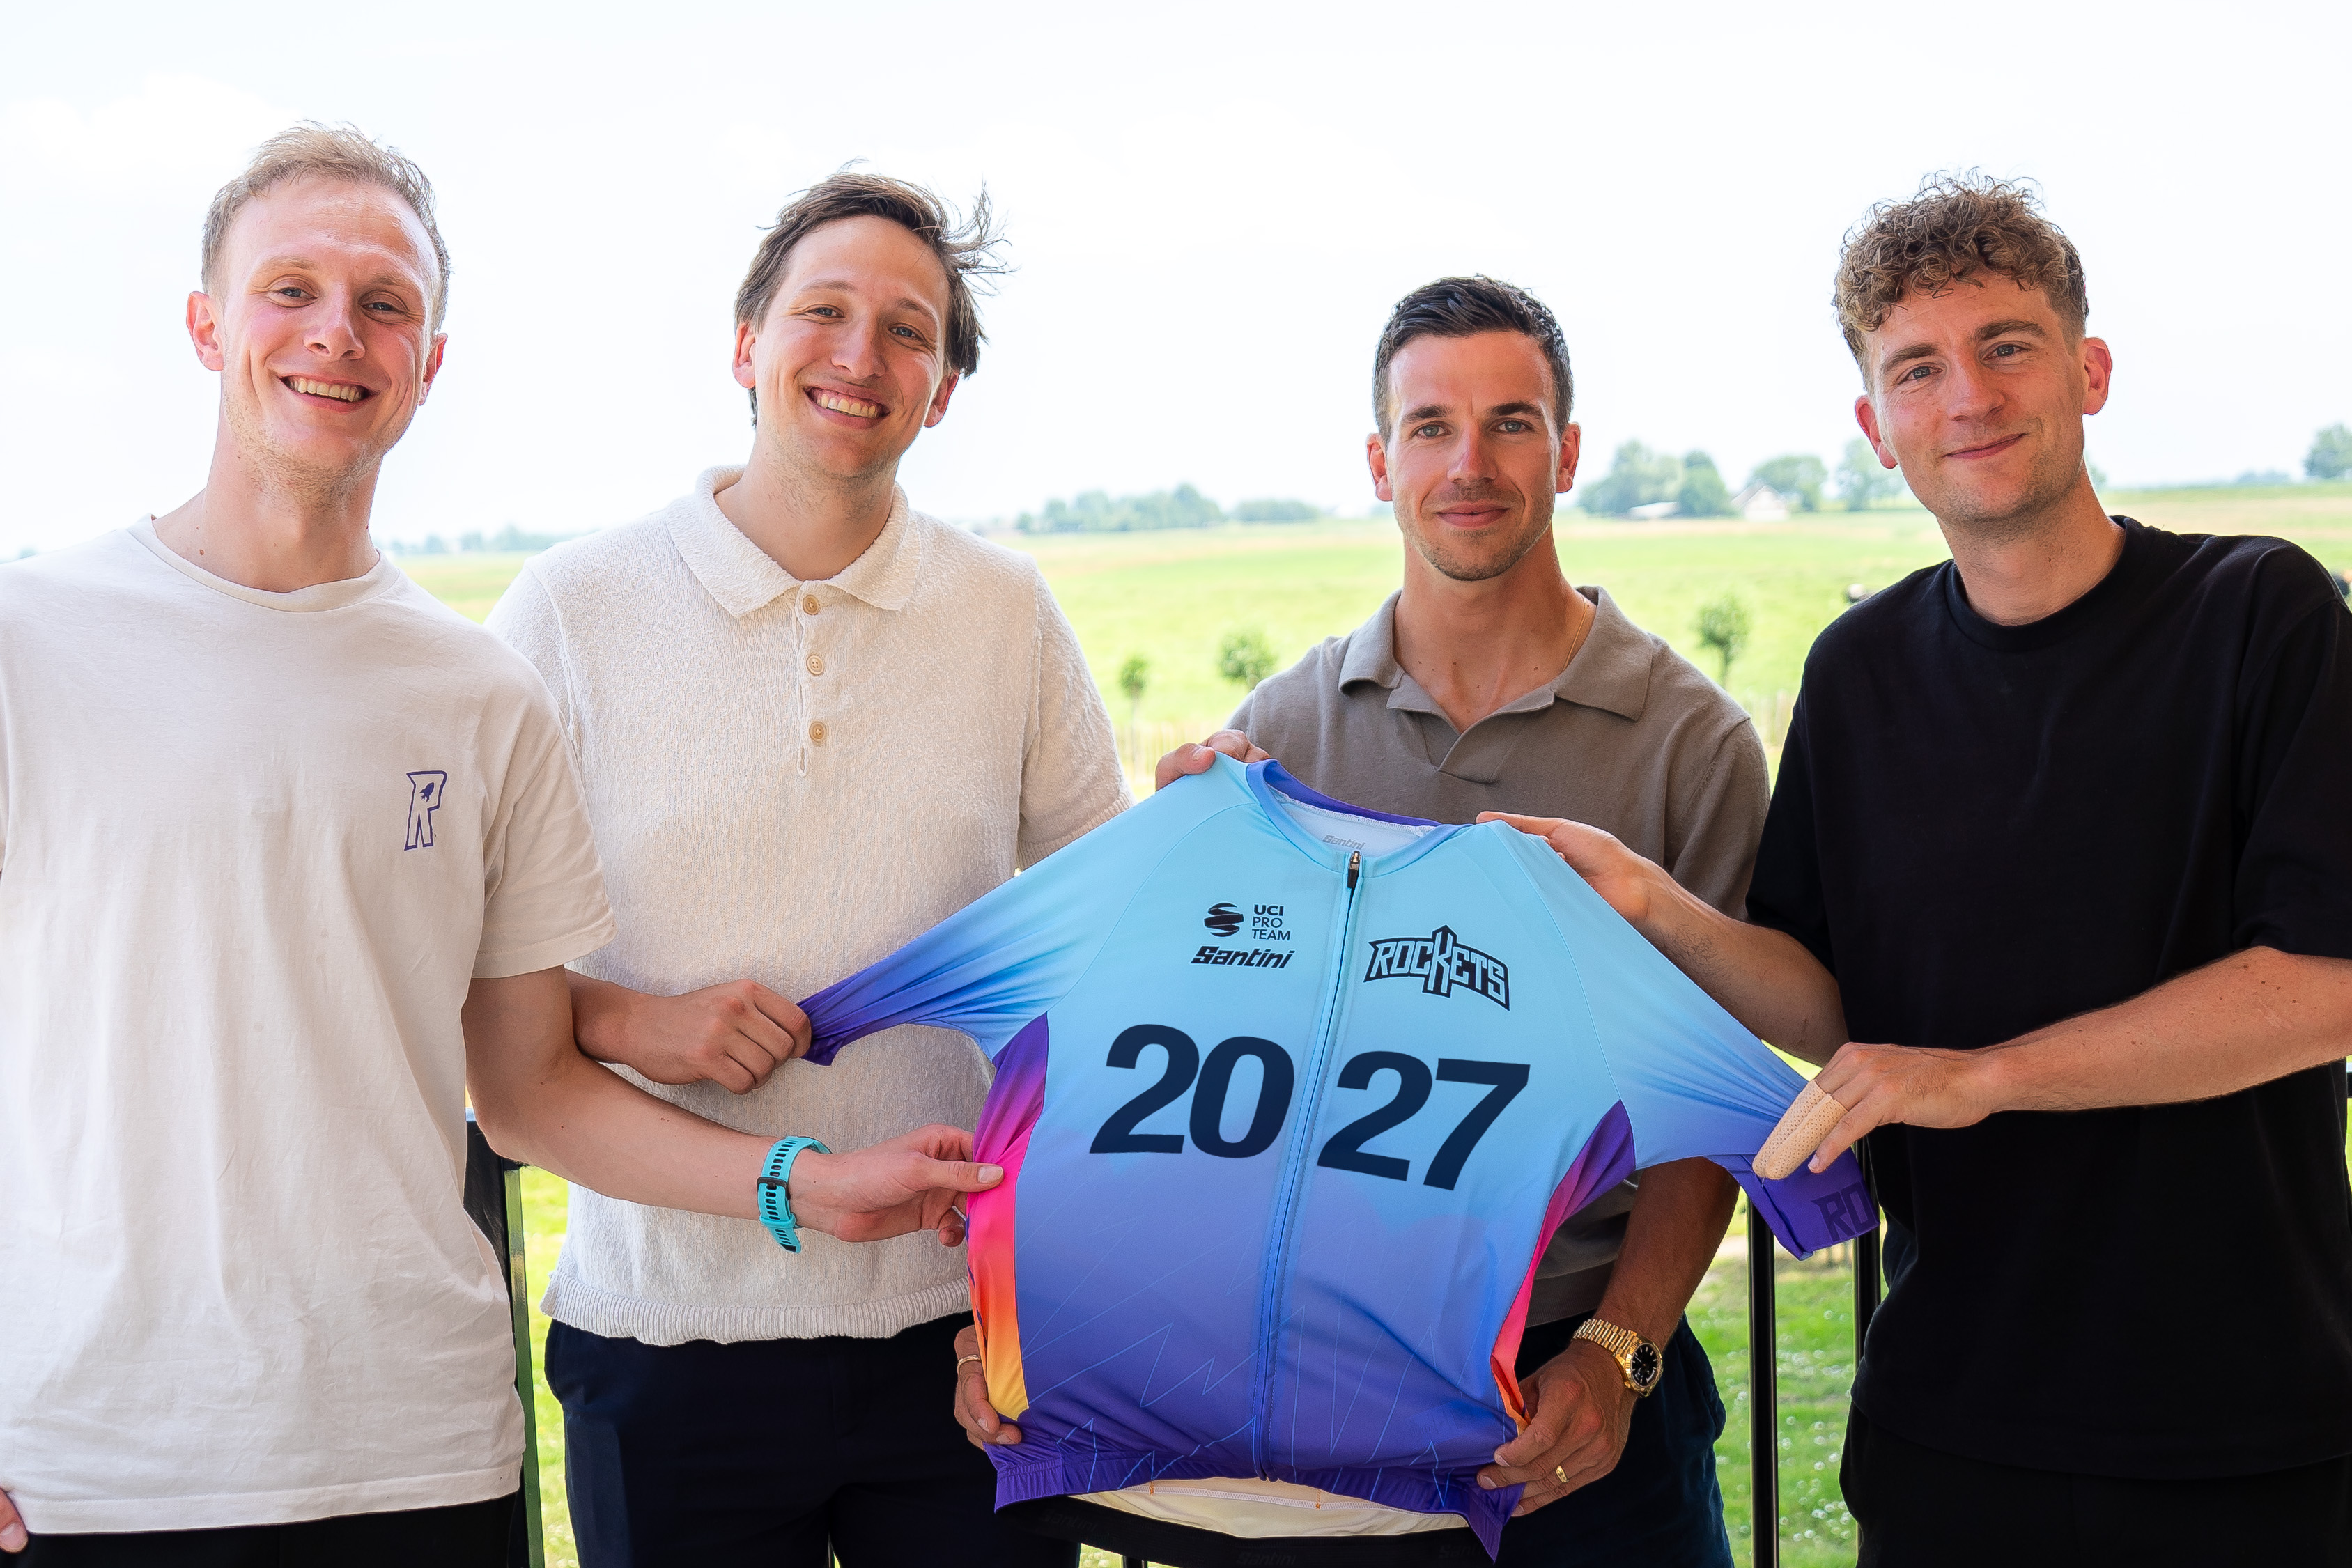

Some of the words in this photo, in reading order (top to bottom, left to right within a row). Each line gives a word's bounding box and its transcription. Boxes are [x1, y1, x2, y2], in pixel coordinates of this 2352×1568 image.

[1322, 835, 1365, 850] Santini
[1253, 904, 1284, 916] UCI
[1252, 916, 1283, 928] PRO
[1251, 929, 1291, 940] TEAM
[1190, 945, 1295, 969] Santini
[1363, 925, 1510, 1011] ROCKETS
[1811, 1181, 1880, 1243] RO
[1236, 1551, 1297, 1566] Santini
